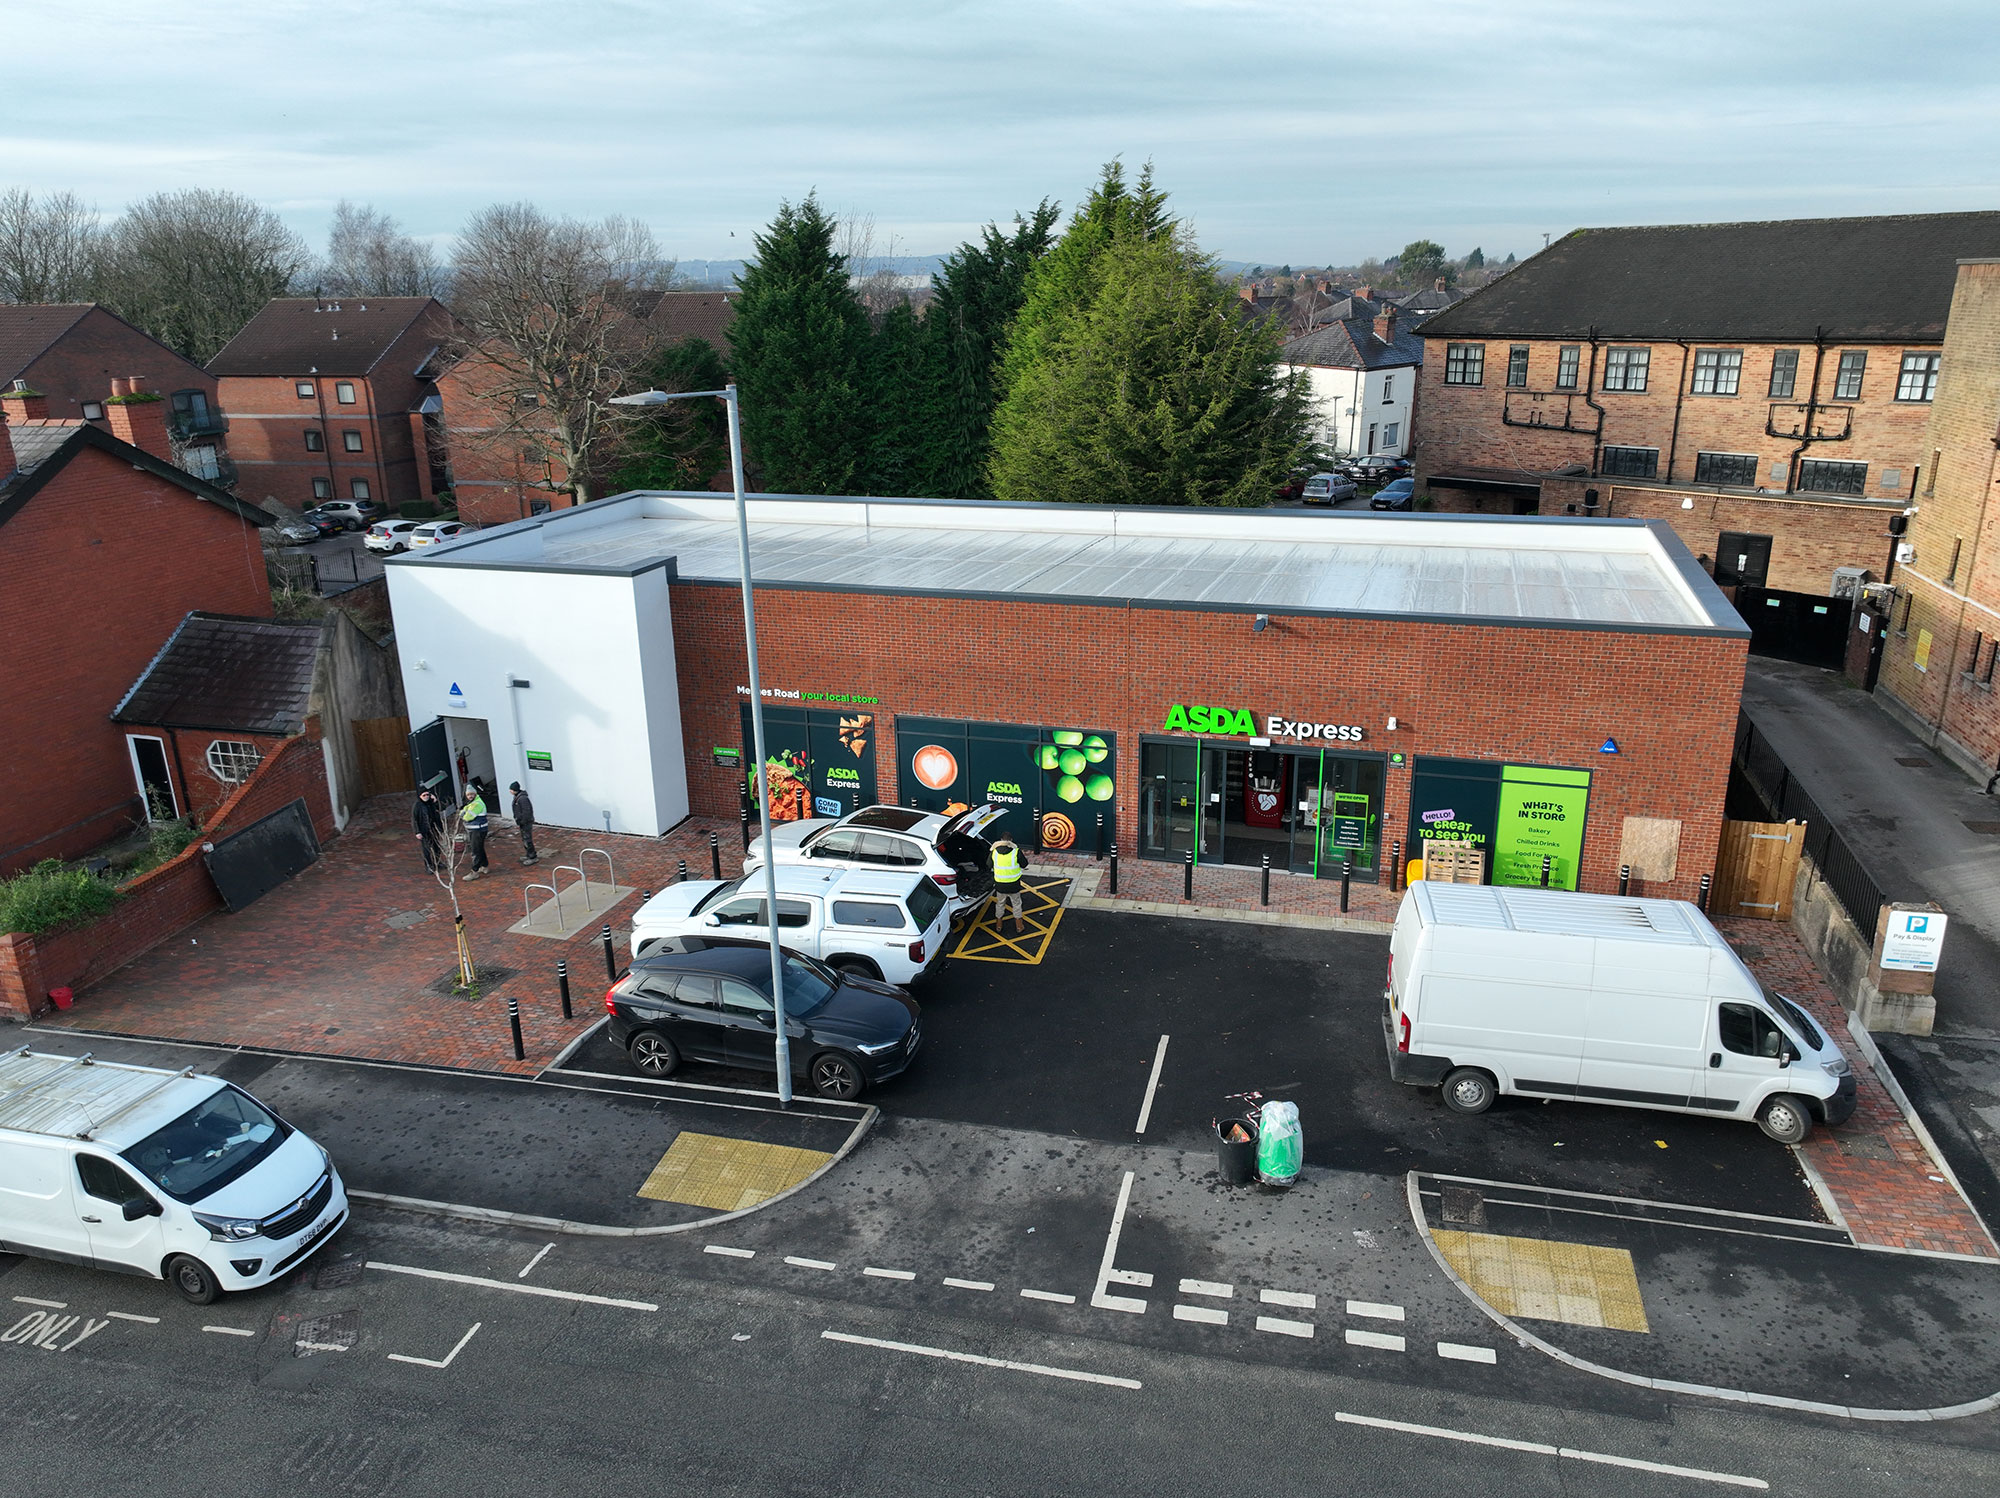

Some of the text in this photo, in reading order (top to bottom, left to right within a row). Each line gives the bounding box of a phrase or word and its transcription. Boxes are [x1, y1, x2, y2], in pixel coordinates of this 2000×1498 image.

[737, 686, 879, 704] Mees Road your local store
[1163, 704, 1363, 741] ASDA Express
[827, 767, 860, 780] ASDA
[826, 778, 860, 789] Express
[987, 781, 1023, 795] ASDA
[986, 792, 1023, 804] Express
[1518, 810, 1529, 818] IN
[1418, 828, 1434, 838] TO
[1528, 827, 1551, 835] Bakery
[1516, 838, 1560, 848] Chilled Drinks
[1505, 873, 1530, 882] Grocery
[1910, 917, 1926, 932] P
[1912, 934, 1936, 942] Display
[0, 1310, 110, 1352] ONLY
